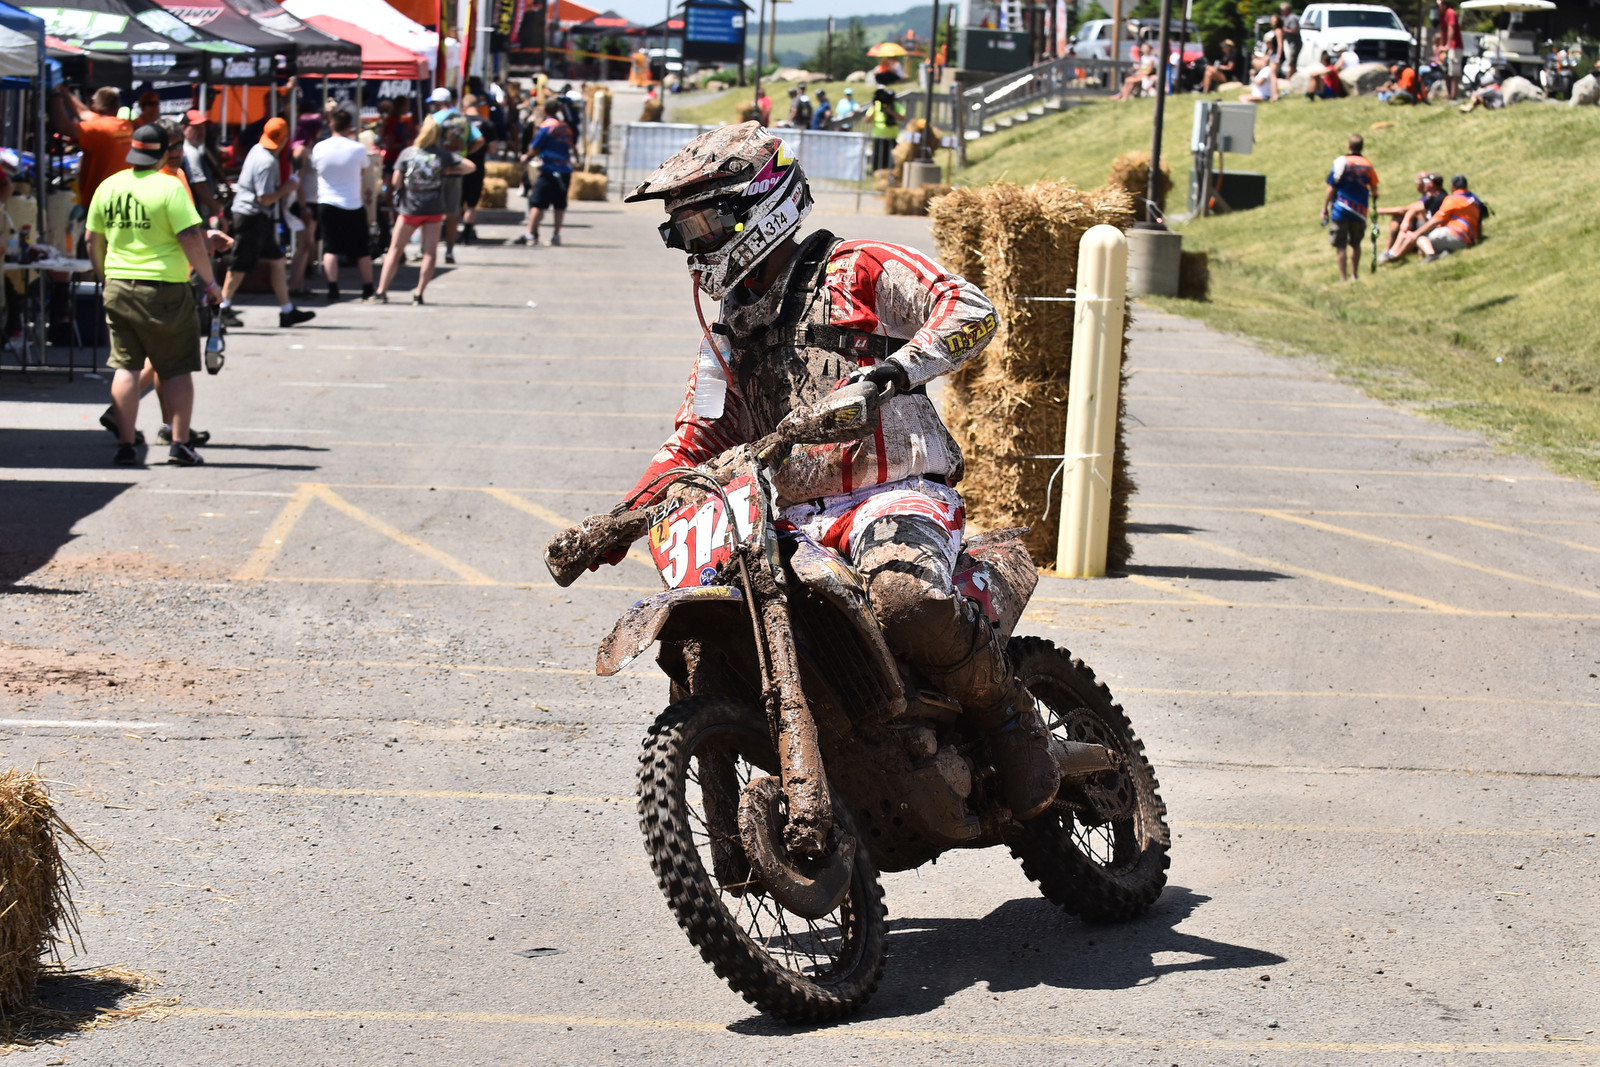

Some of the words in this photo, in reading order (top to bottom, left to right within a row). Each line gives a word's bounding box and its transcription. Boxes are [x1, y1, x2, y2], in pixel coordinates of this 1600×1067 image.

[764, 211, 788, 236] 314
[656, 522, 666, 544] 2
[660, 484, 754, 590] 314
